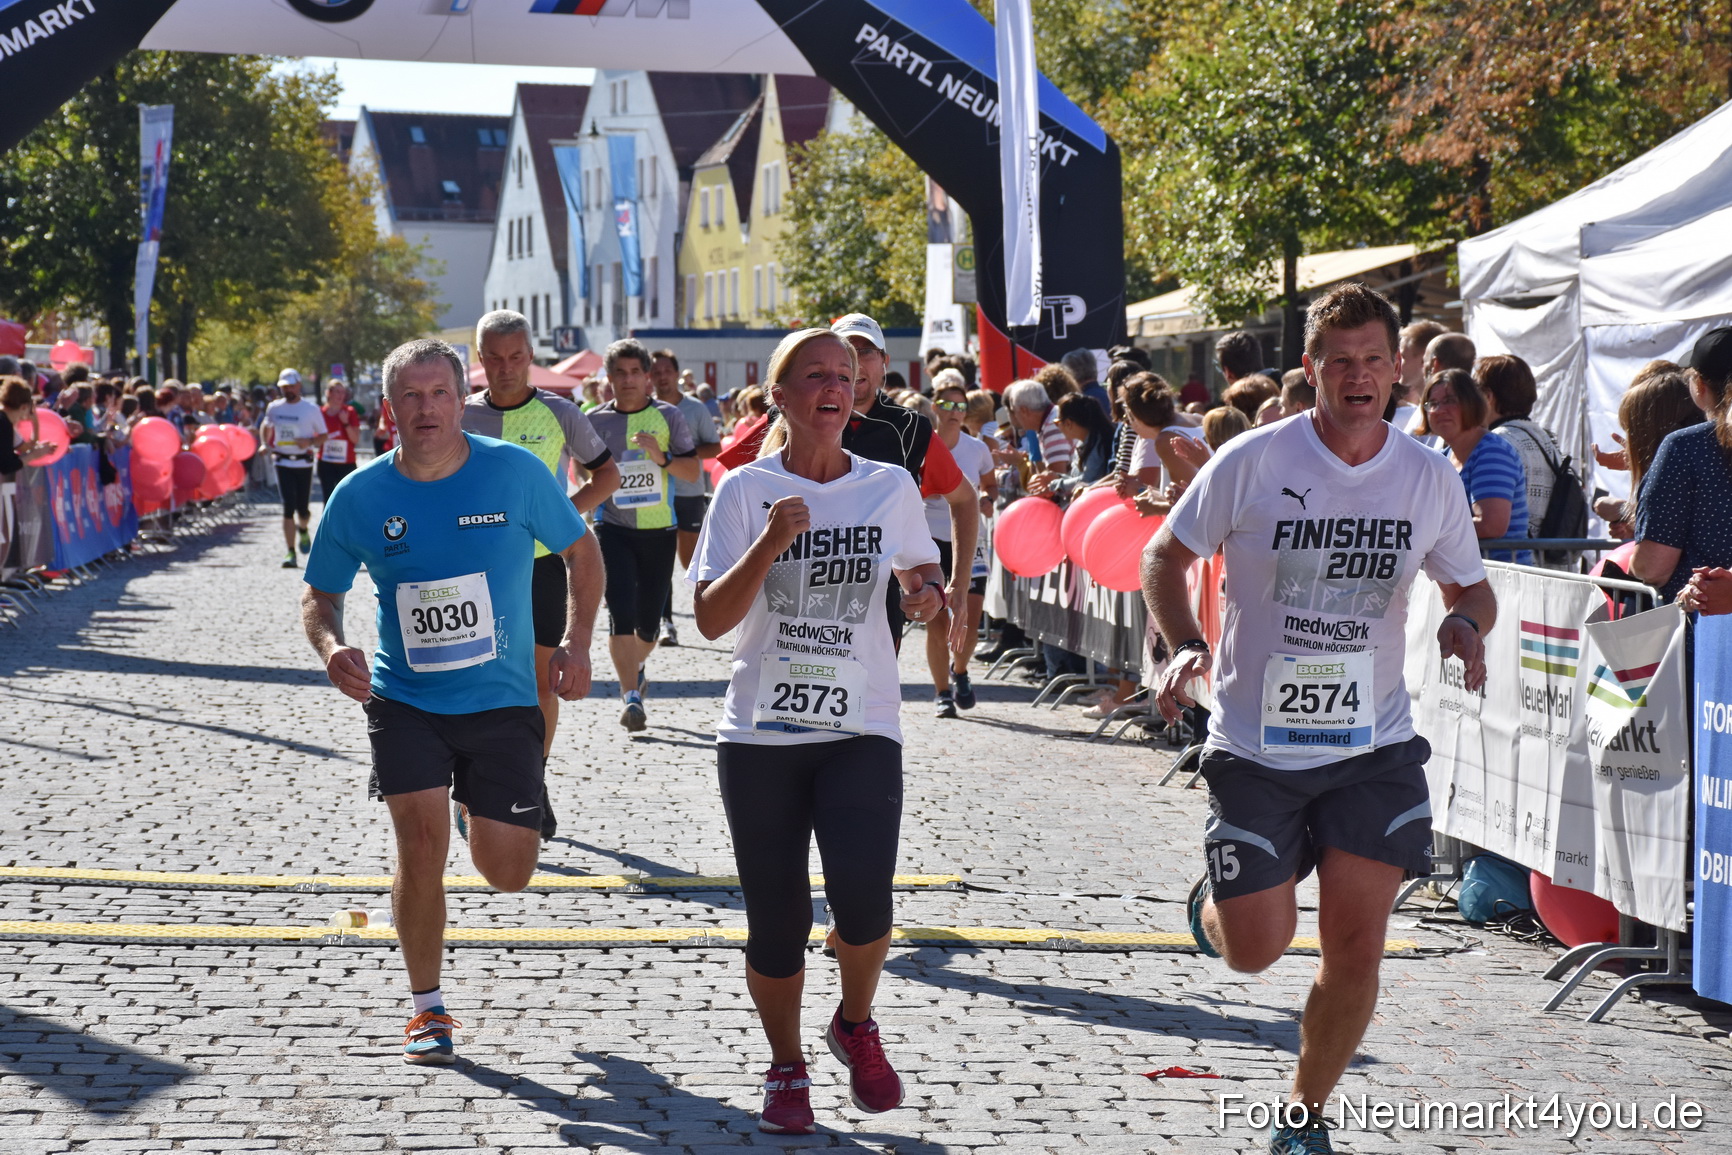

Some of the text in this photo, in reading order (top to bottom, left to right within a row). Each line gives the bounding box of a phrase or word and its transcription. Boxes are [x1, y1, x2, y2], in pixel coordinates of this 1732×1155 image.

[855, 23, 934, 88] PARTL
[620, 472, 655, 490] 2228
[457, 511, 508, 527] BOCK
[1271, 518, 1414, 551] FINISHER
[384, 542, 410, 552] PARTL
[809, 557, 872, 588] 2018
[1326, 551, 1398, 580] 2018
[420, 585, 460, 599] BOCK
[411, 601, 478, 634] 3030
[1284, 614, 1370, 642] medwork
[420, 634, 468, 645] PARTL Neumarkt
[776, 639, 851, 658] TRIATHLON HÖCHSTADT
[1283, 634, 1366, 653] TRIATHLON HÖCHSTADT
[789, 663, 836, 678] BOCK
[1296, 663, 1346, 676] BOCK
[770, 682, 849, 717] 2573
[1279, 681, 1361, 714] 2574
[799, 718, 831, 727] Neumarkt
[1285, 717, 1345, 726] PARTL Neumarkt
[1288, 730, 1352, 745] Bernhard
[1617, 765, 1661, 781] genießen
[1209, 844, 1241, 883] 15
